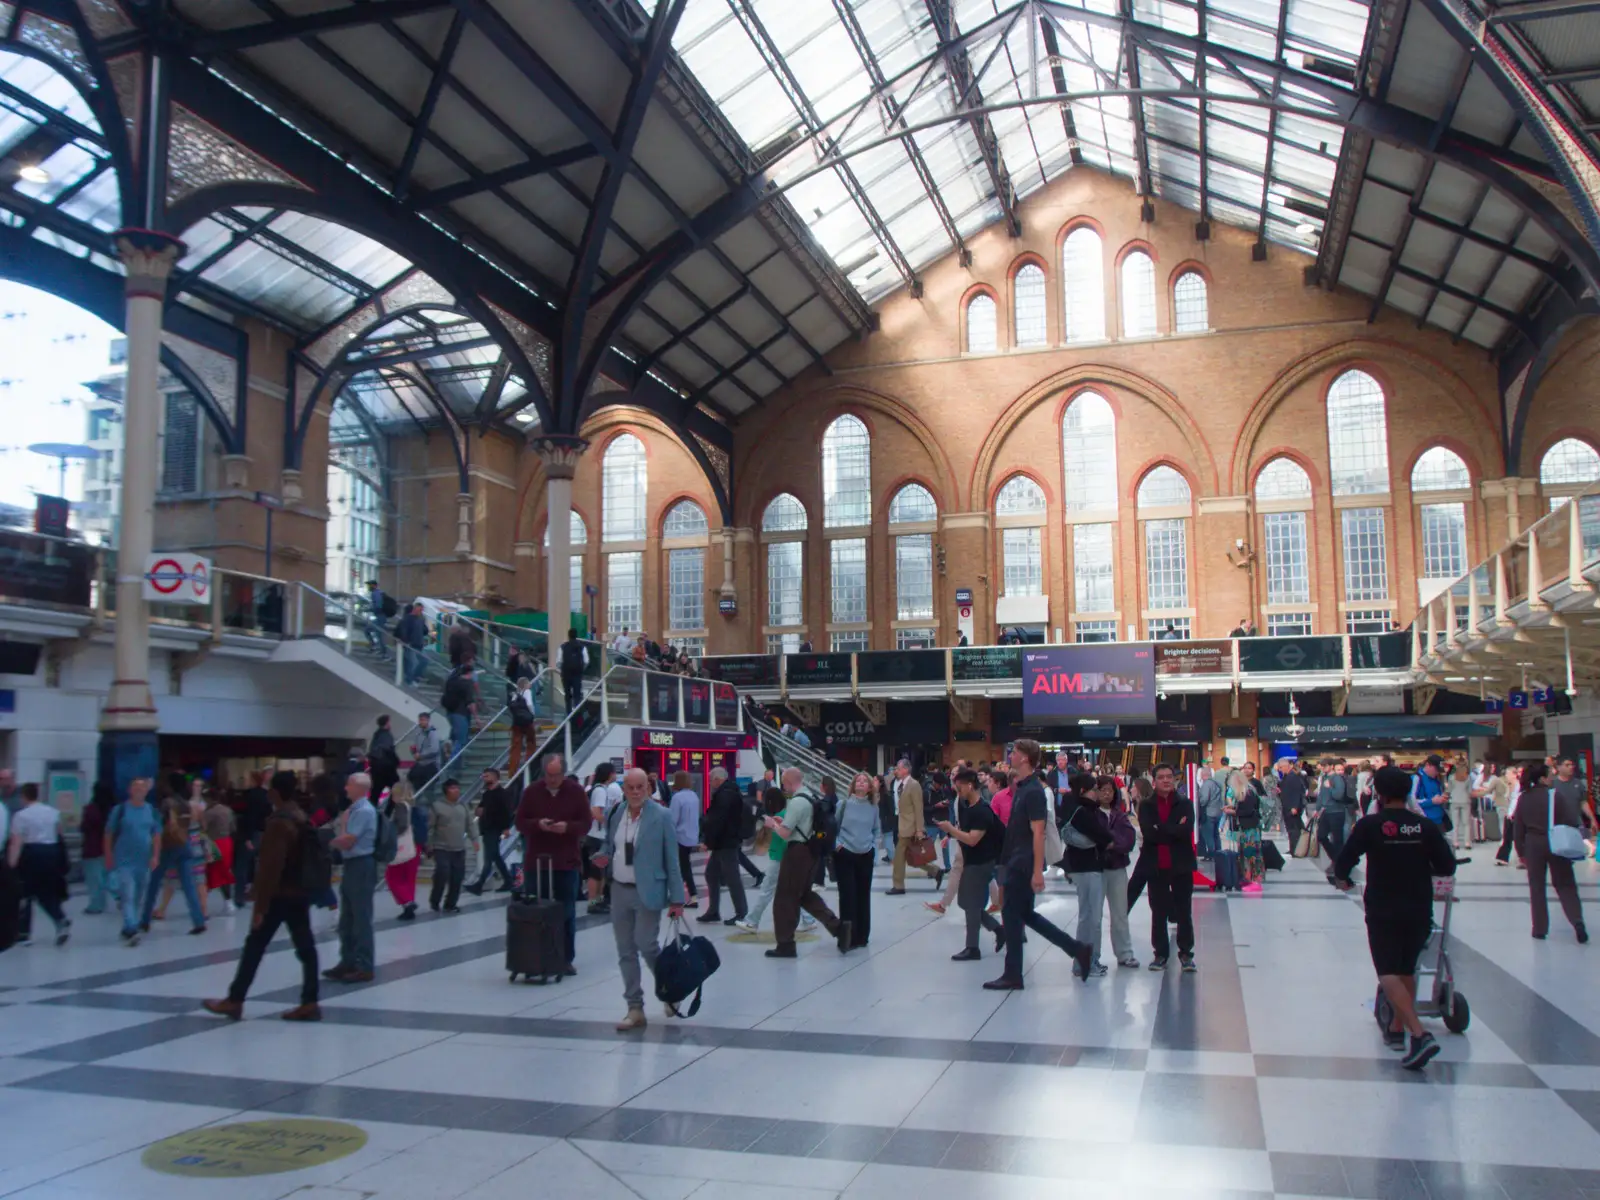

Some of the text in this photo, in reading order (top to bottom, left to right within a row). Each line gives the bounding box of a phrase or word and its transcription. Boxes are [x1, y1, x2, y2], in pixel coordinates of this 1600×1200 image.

[1164, 648, 1189, 656] Brighter
[1031, 673, 1082, 695] AIM
[1515, 694, 1522, 706] 2
[1540, 689, 1548, 701] 3
[824, 721, 875, 735] COSTA
[1307, 724, 1316, 732] to
[1317, 724, 1348, 732] London
[1399, 823, 1422, 836] dpd
